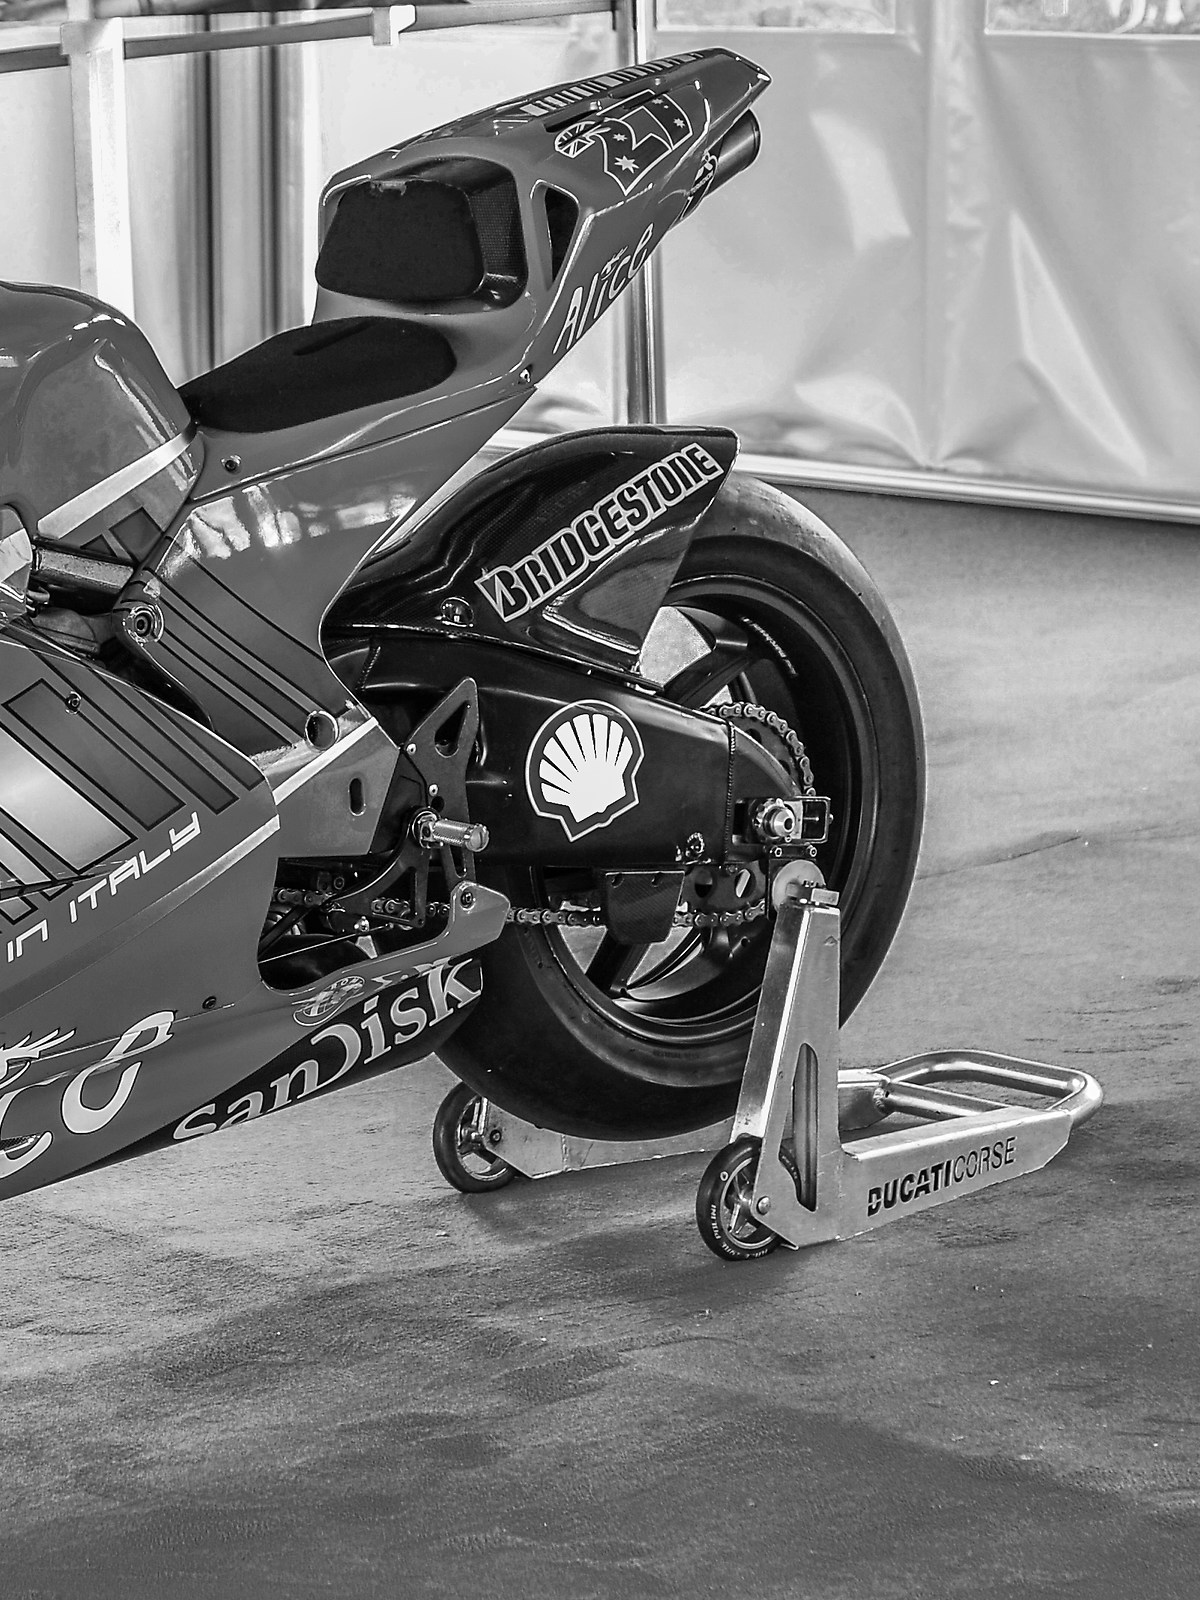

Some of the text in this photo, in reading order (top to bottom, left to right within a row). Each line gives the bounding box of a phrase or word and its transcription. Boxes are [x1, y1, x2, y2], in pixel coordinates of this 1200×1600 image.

[553, 223, 653, 354] Alice
[474, 442, 724, 622] BRIDGESTONE
[69, 811, 201, 923] ITALY
